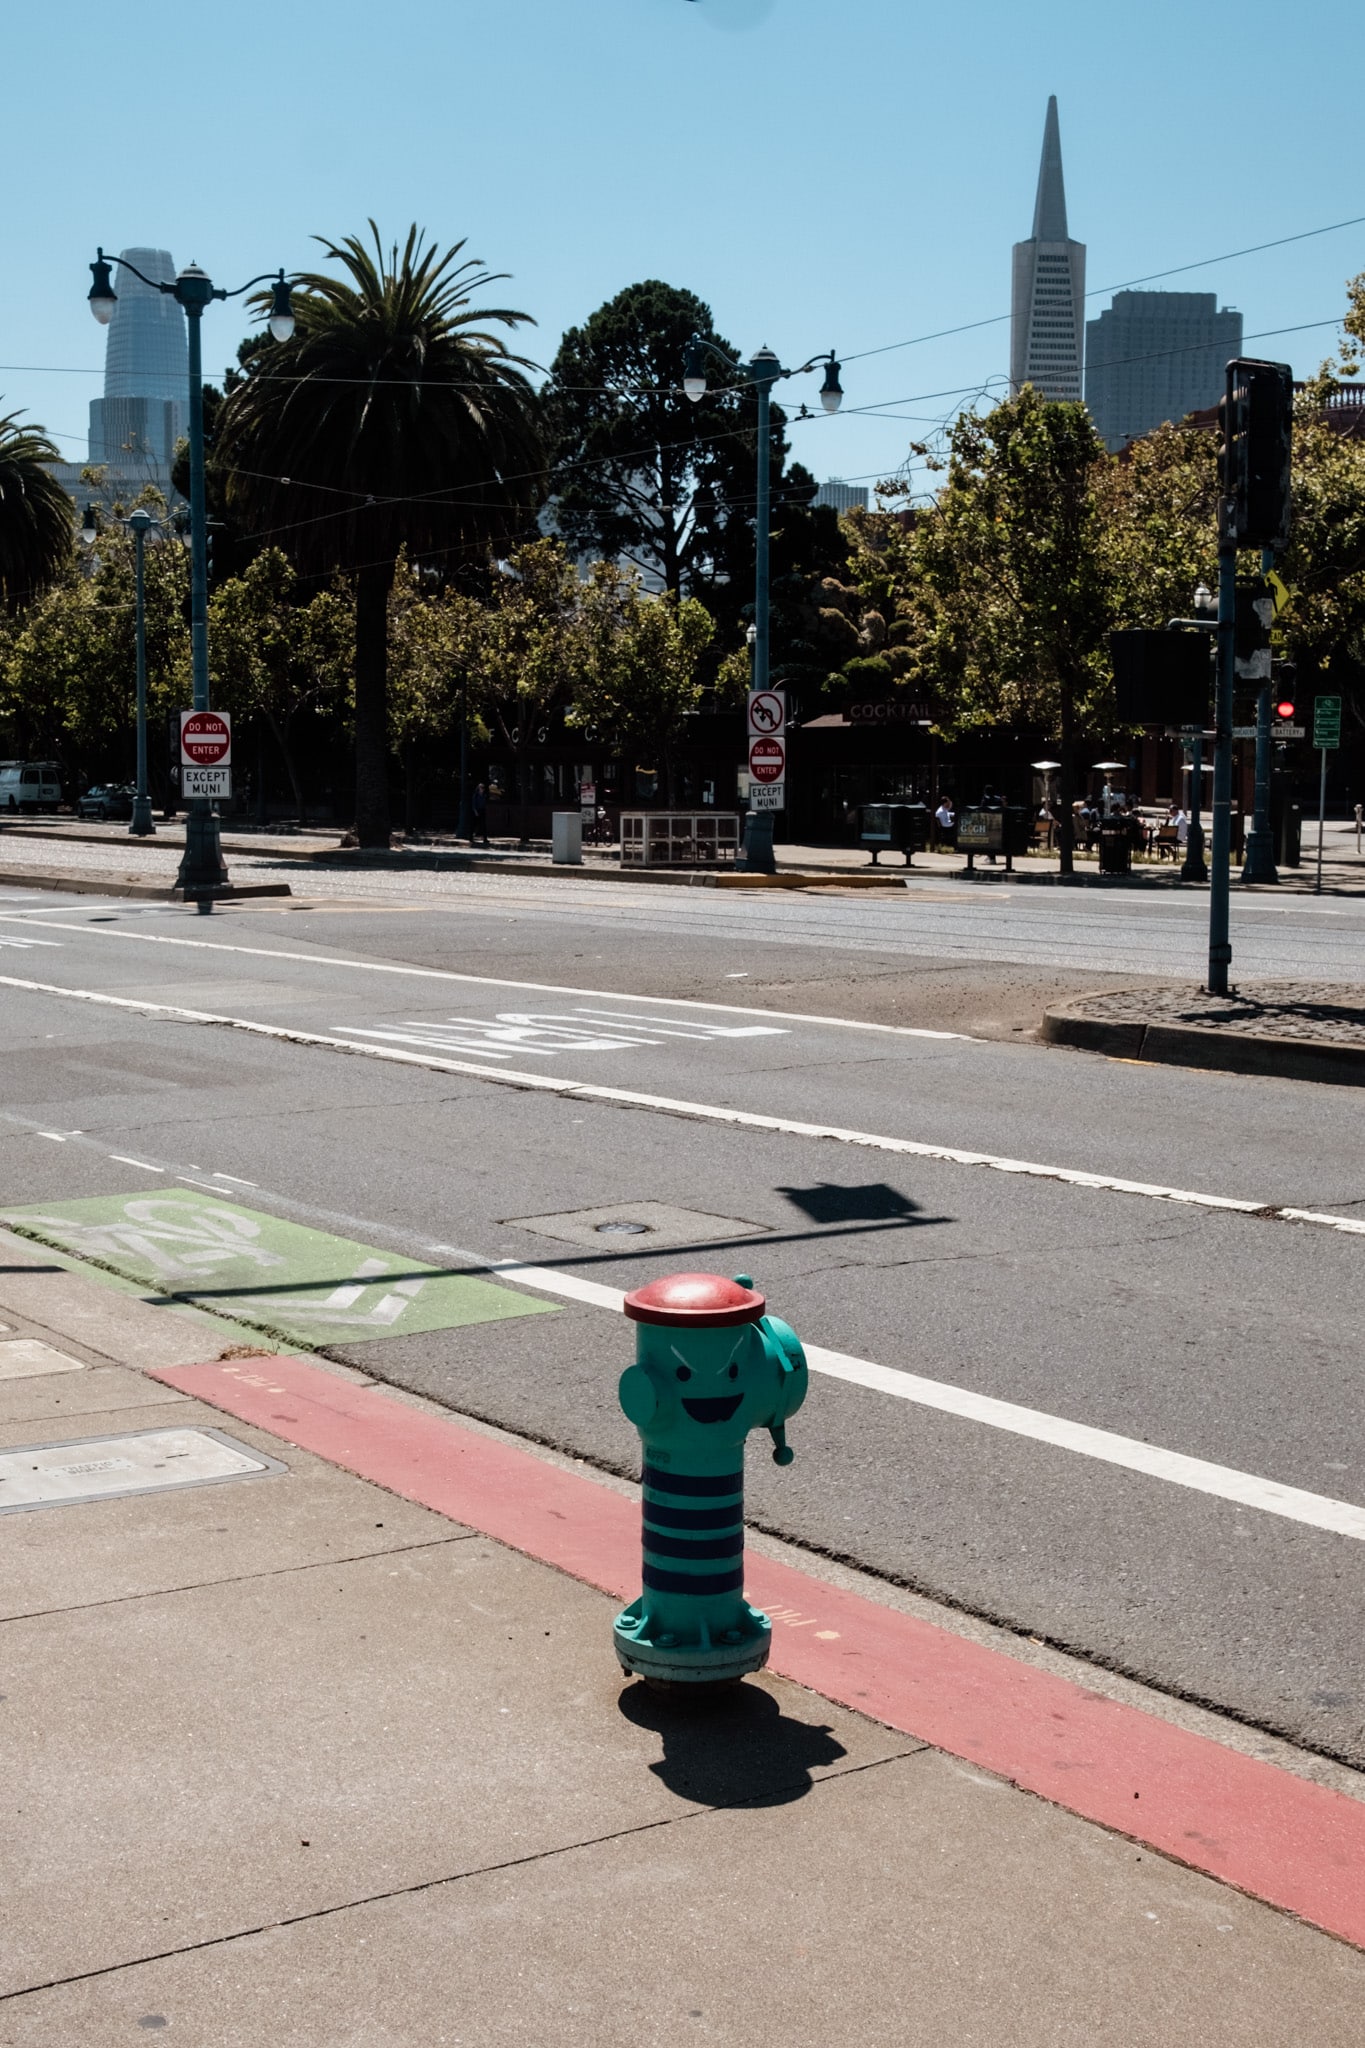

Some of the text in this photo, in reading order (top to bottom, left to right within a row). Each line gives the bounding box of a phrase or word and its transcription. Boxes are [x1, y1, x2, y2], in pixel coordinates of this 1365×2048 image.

[189, 723, 222, 731] DO NOT
[192, 746, 219, 754] ENTER
[186, 772, 226, 781] EXCEPT
[192, 784, 220, 793] MUNI
[752, 787, 781, 797] EXCEPT
[757, 799, 777, 807] MUNI
